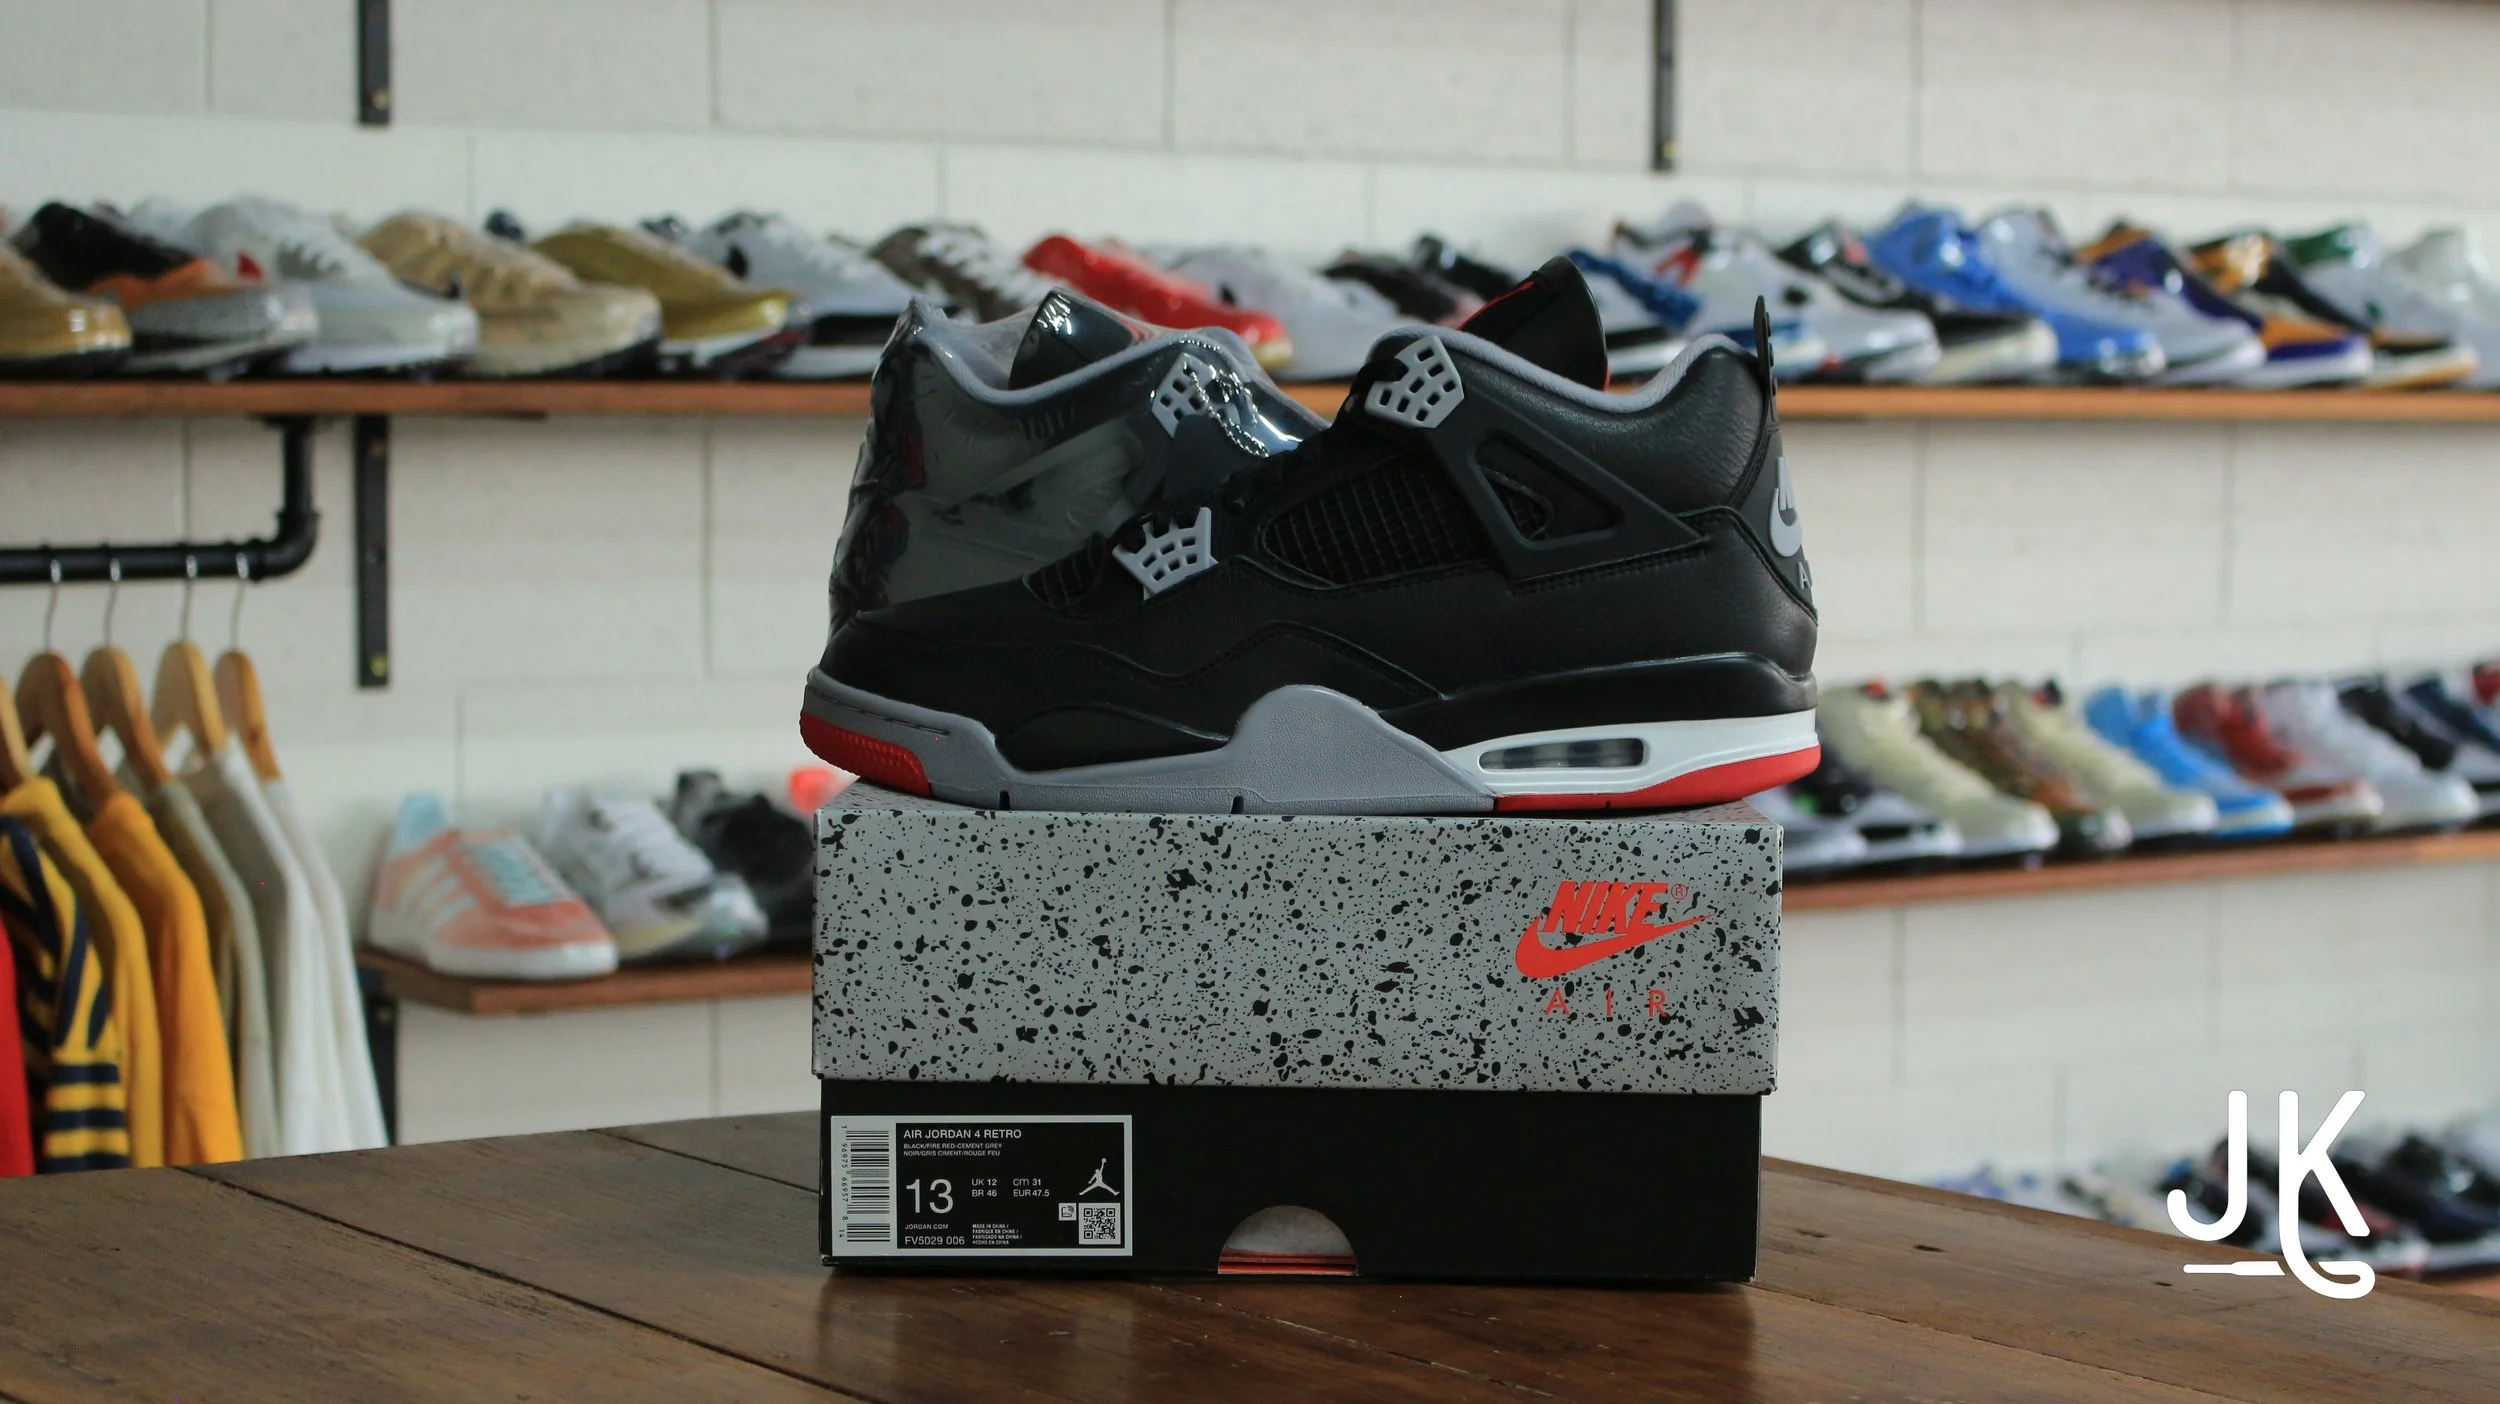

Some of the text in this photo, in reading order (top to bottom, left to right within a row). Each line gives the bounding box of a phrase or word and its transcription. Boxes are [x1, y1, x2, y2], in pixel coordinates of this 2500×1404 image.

[903, 1129, 1022, 1139] AIR JORDAN 4 RETRO
[971, 1178, 984, 1186] UK
[987, 1178, 998, 1186] 12
[1032, 1178, 1042, 1186] 31
[905, 1178, 954, 1214] 13
[971, 1189, 1050, 1197] BR 46 EUR 47.5
[904, 1236, 966, 1245] FV5029 006
